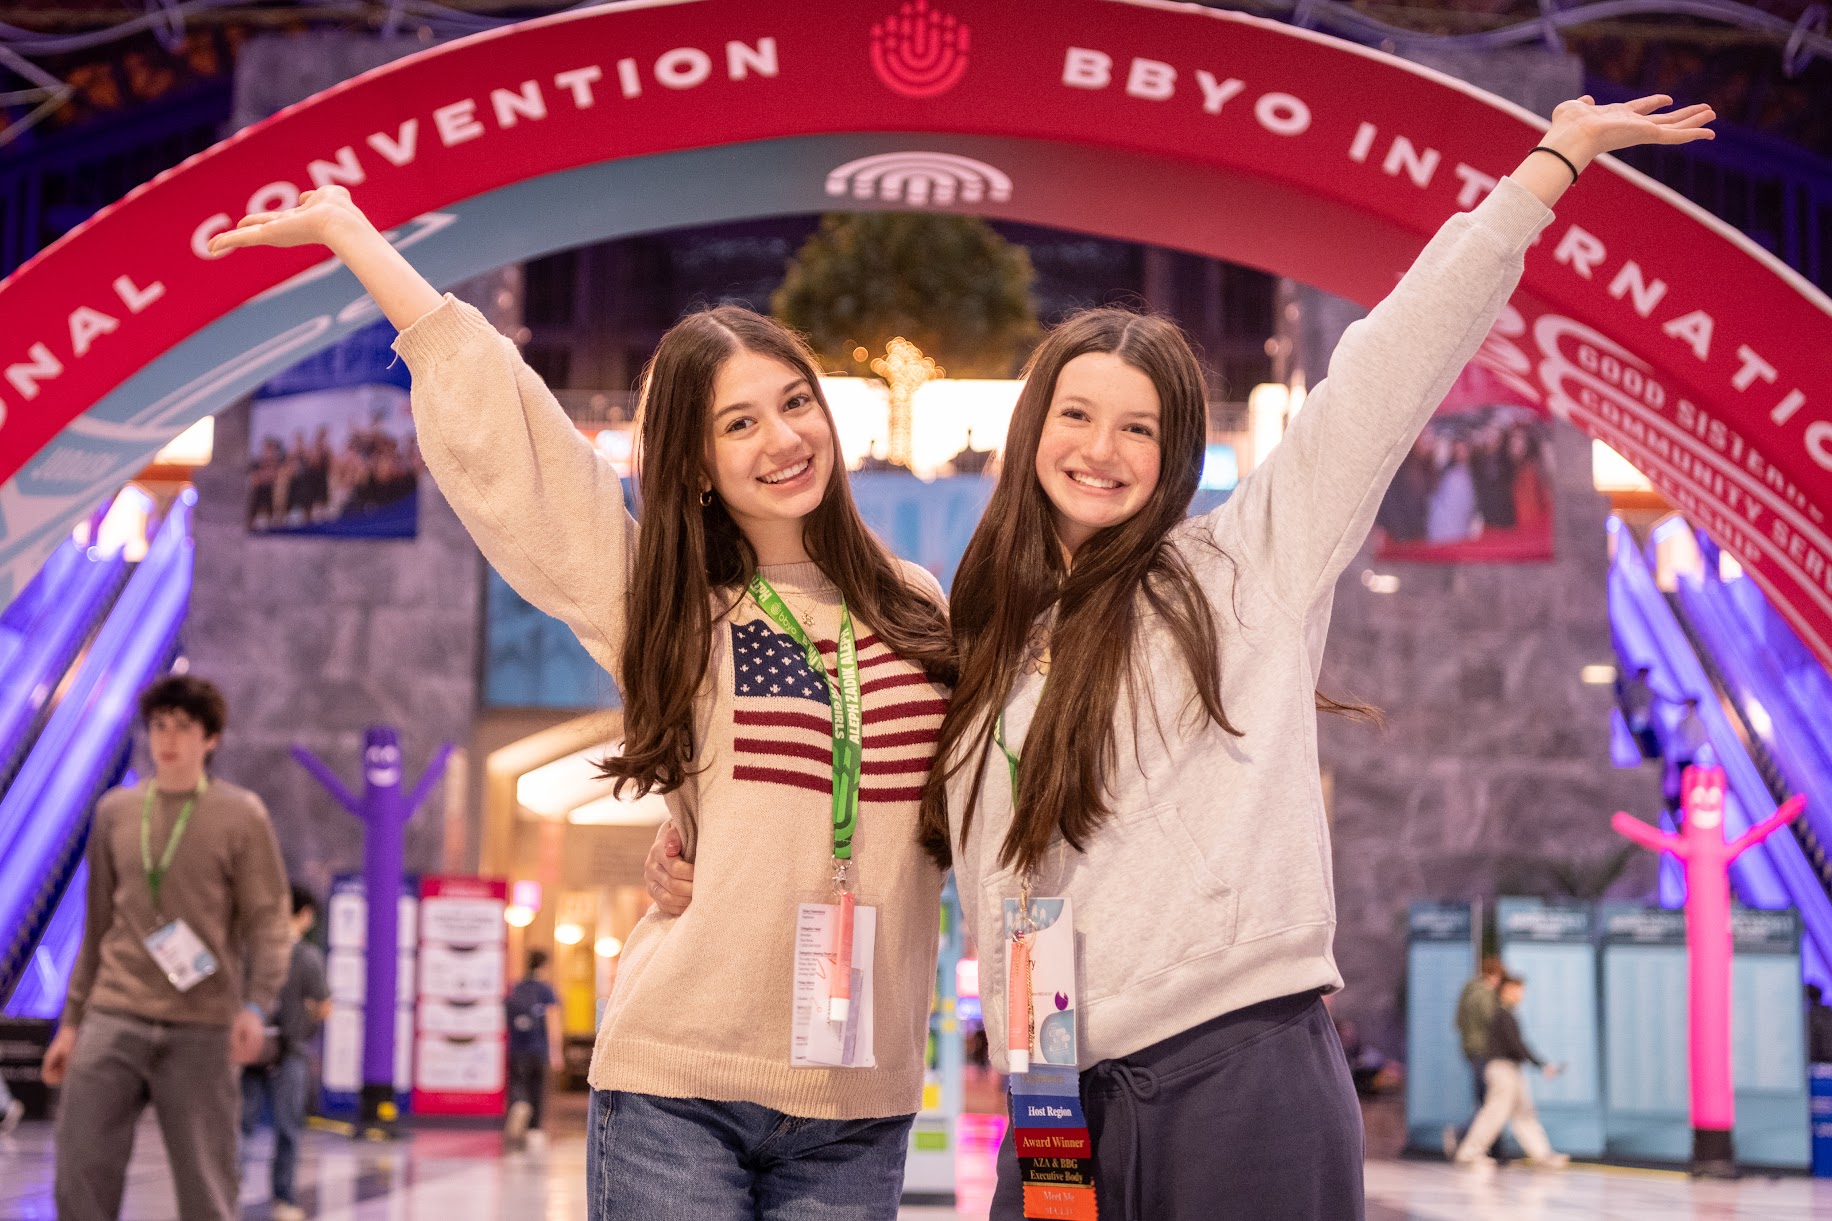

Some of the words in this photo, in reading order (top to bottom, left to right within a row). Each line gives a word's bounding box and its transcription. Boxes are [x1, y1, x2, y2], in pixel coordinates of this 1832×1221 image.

[0, 275, 166, 431] NAL
[191, 36, 780, 260] CONVENTION
[1062, 46, 1311, 136] BBYO
[1348, 122, 1832, 473] INTRNATIO
[1578, 344, 1665, 411] GOOD
[1580, 387, 1763, 523] COMMUNITY
[750, 576, 773, 603] LEPH
[779, 612, 797, 635] bbyo
[840, 627, 855, 665] ALEPH
[841, 666, 859, 703] ZADIK
[833, 700, 845, 740] GIRLS
[848, 703, 860, 745] ALEPH
[1028, 1106, 1046, 1117] Host
[1047, 1106, 1072, 1118] Region
[1023, 1136, 1050, 1147] Award
[1052, 1136, 1084, 1147] Winner
[1030, 1169, 1064, 1181] Executive
[1065, 1171, 1083, 1183] Body
[1033, 1158, 1050, 1168] AZA
[1052, 1158, 1060, 1168] &
[1060, 1158, 1078, 1169] BBG
[1043, 1190, 1062, 1201] Meet
